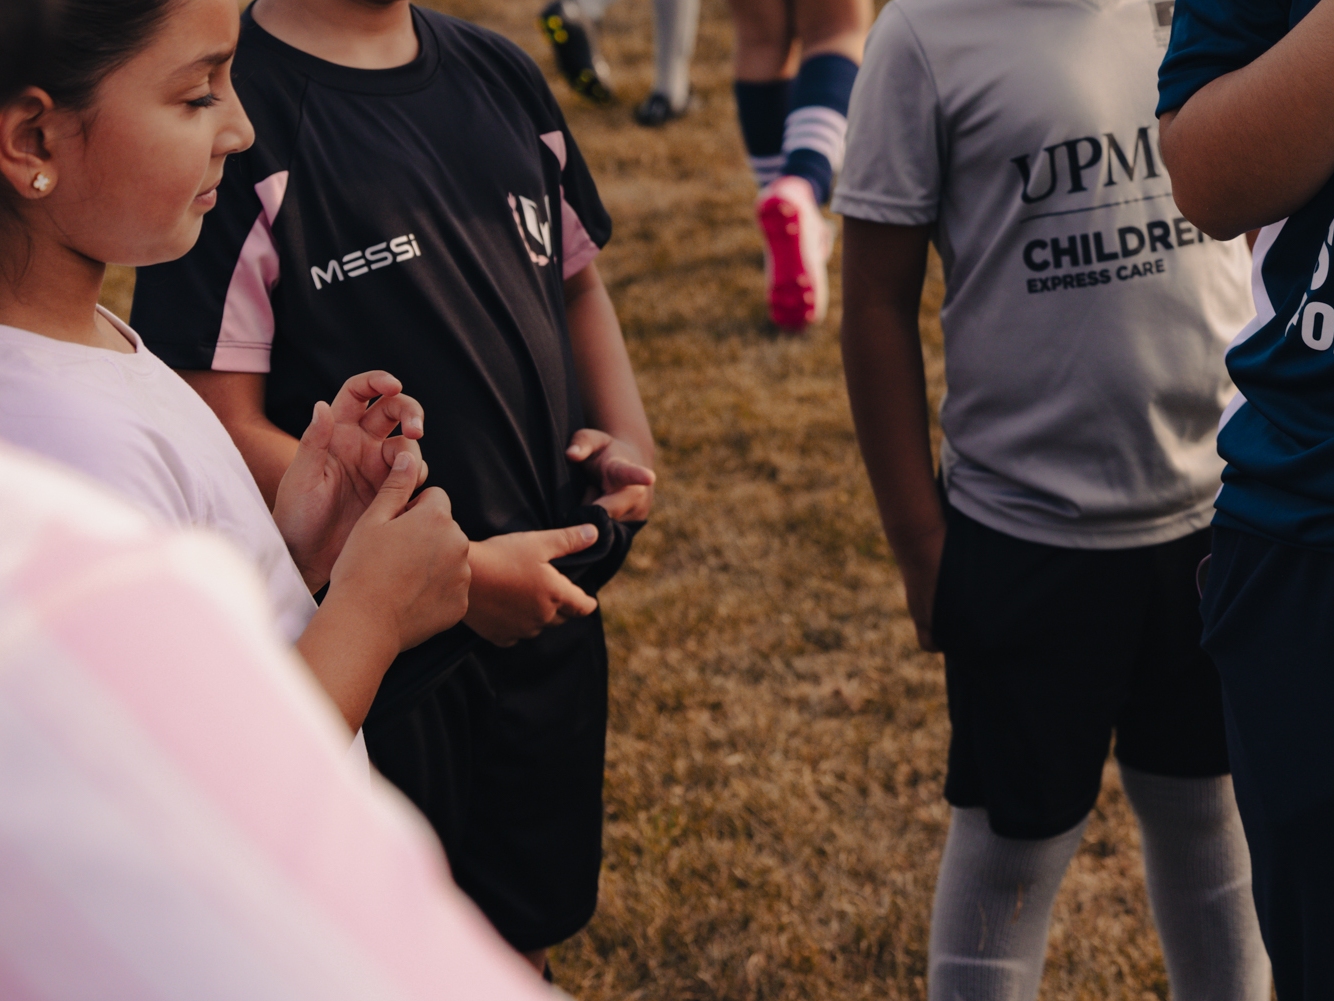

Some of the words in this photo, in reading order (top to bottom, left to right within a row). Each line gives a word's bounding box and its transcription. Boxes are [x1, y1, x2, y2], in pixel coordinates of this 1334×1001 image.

[1010, 126, 1166, 205] UPM
[1026, 268, 1112, 295] EXPRESS
[1115, 258, 1166, 283] CARE
